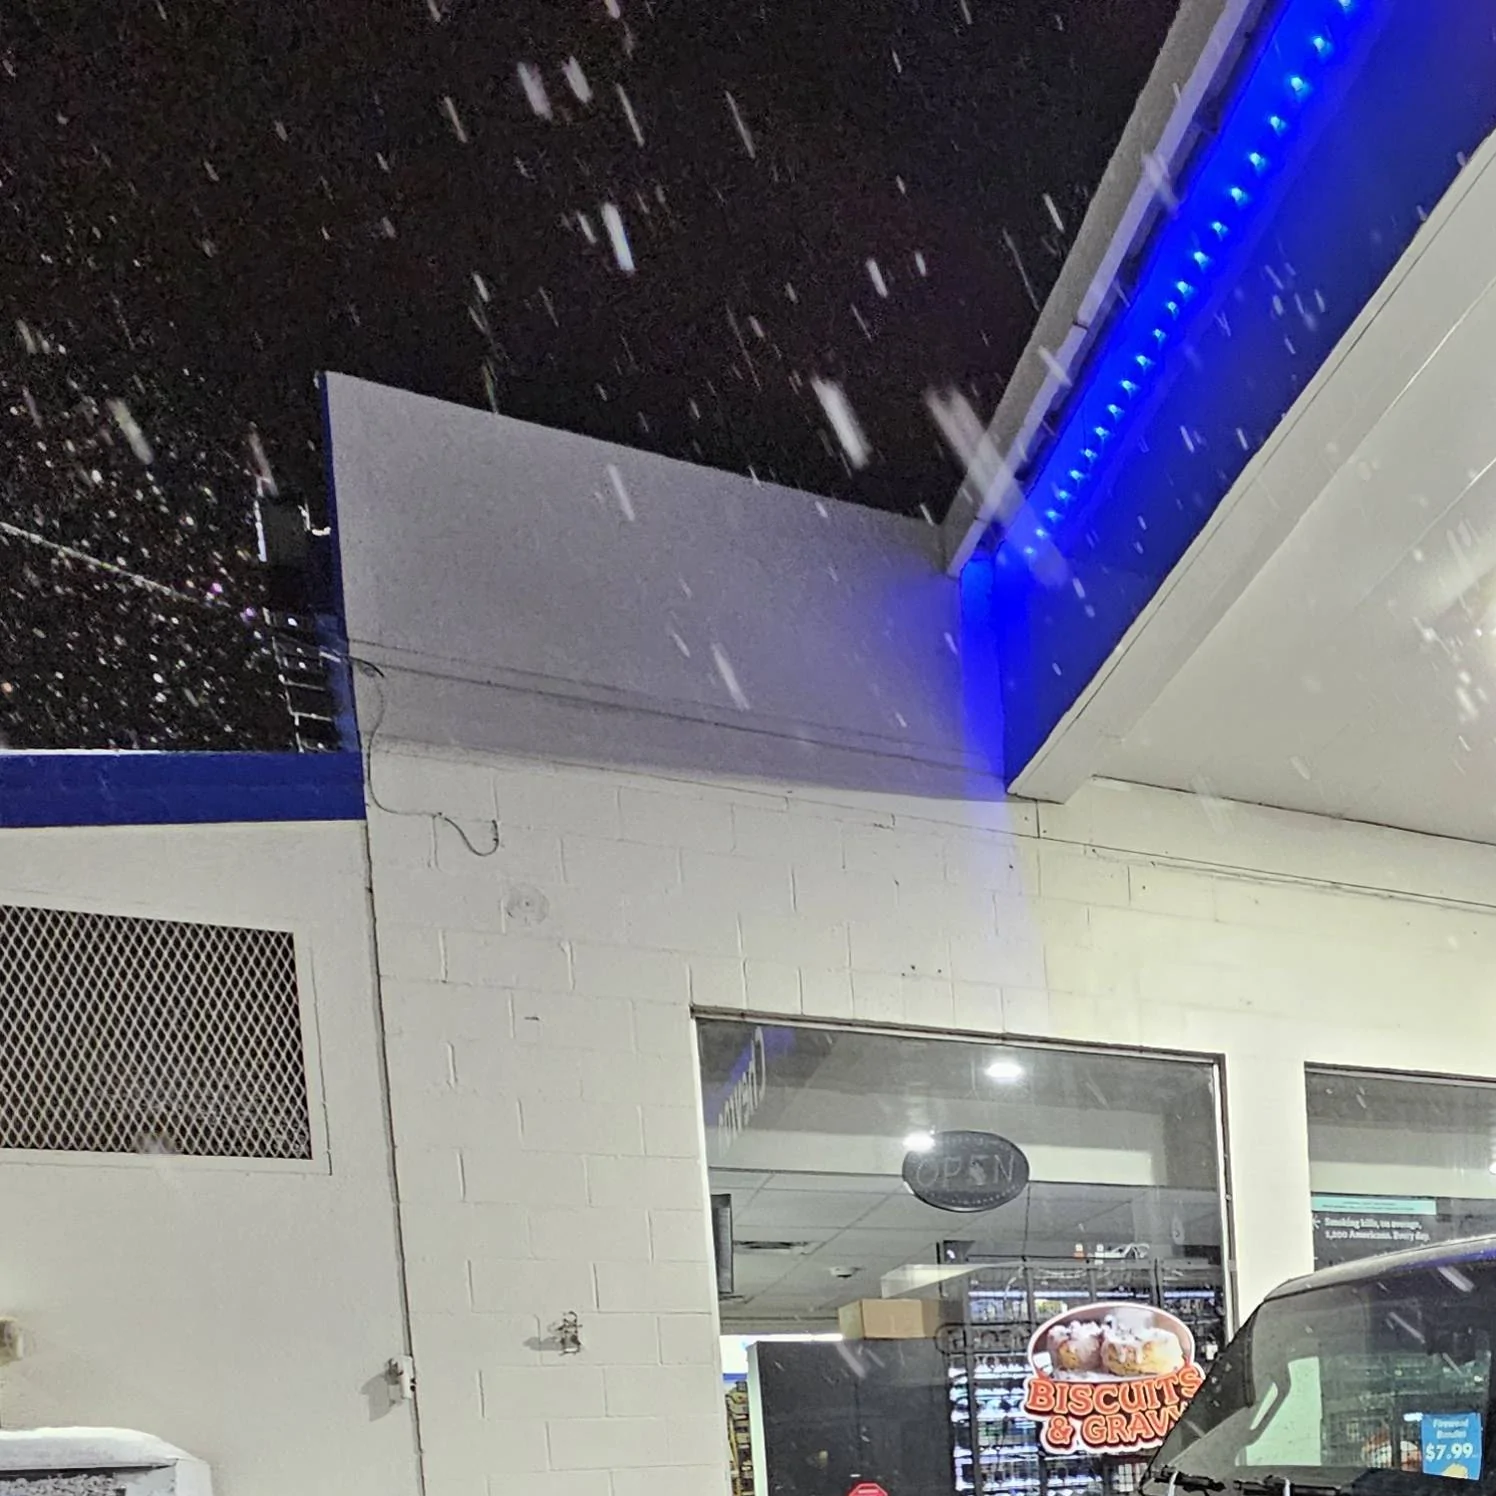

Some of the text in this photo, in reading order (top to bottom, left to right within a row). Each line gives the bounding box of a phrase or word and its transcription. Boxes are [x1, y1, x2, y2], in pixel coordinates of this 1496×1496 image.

[916, 1151, 1014, 1190] OPEN
[1026, 1366, 1203, 1416] BISCUITS
[1047, 1415, 1073, 1445] &
[1425, 1441, 1473, 1462] $7.99
